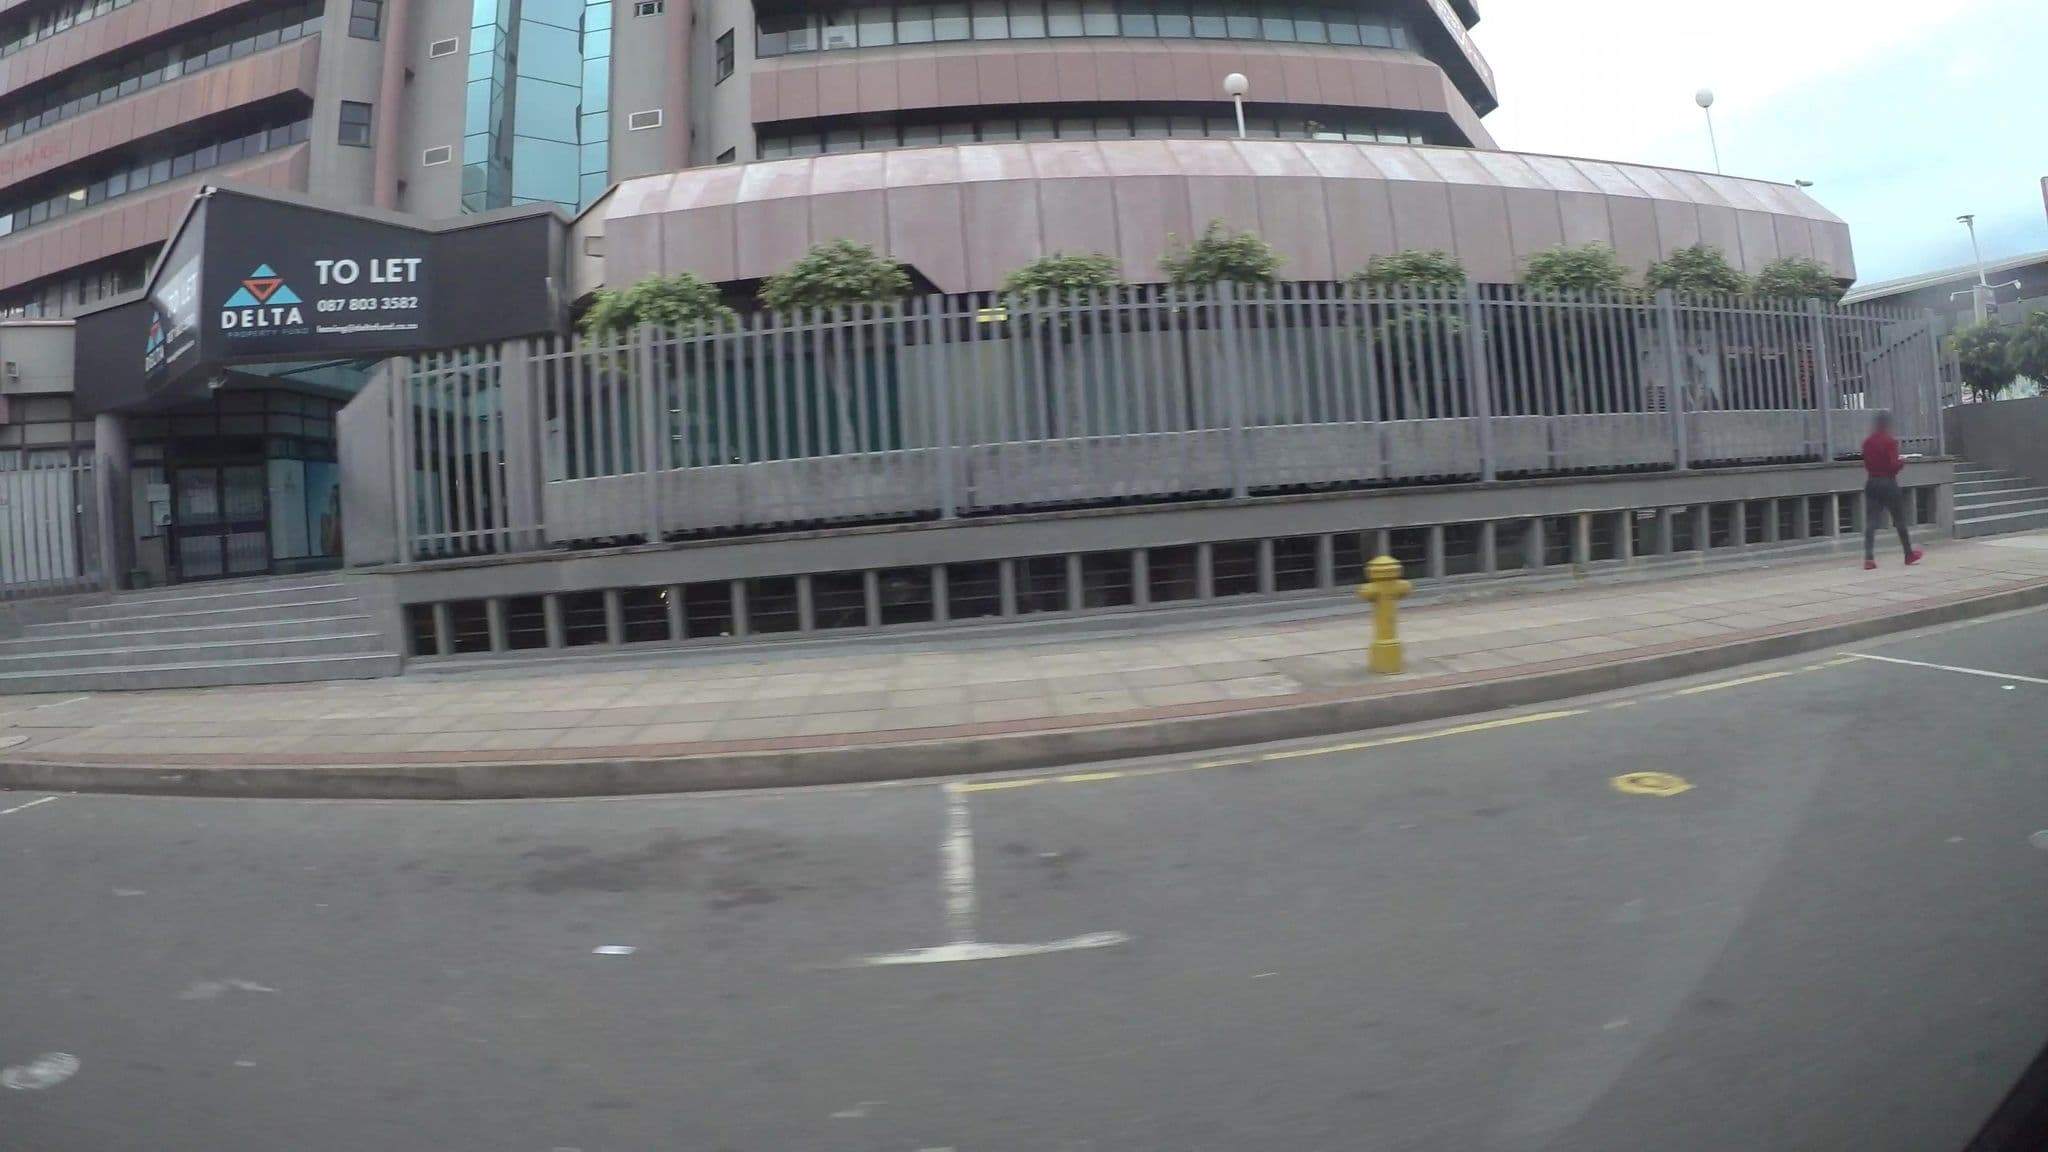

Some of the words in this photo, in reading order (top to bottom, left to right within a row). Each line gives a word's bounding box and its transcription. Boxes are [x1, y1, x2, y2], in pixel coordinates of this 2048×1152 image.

[315, 259, 359, 285] TO
[370, 258, 422, 283] LET
[317, 299, 346, 312] 087
[348, 298, 378, 311] 803
[221, 307, 304, 329] DELTA
